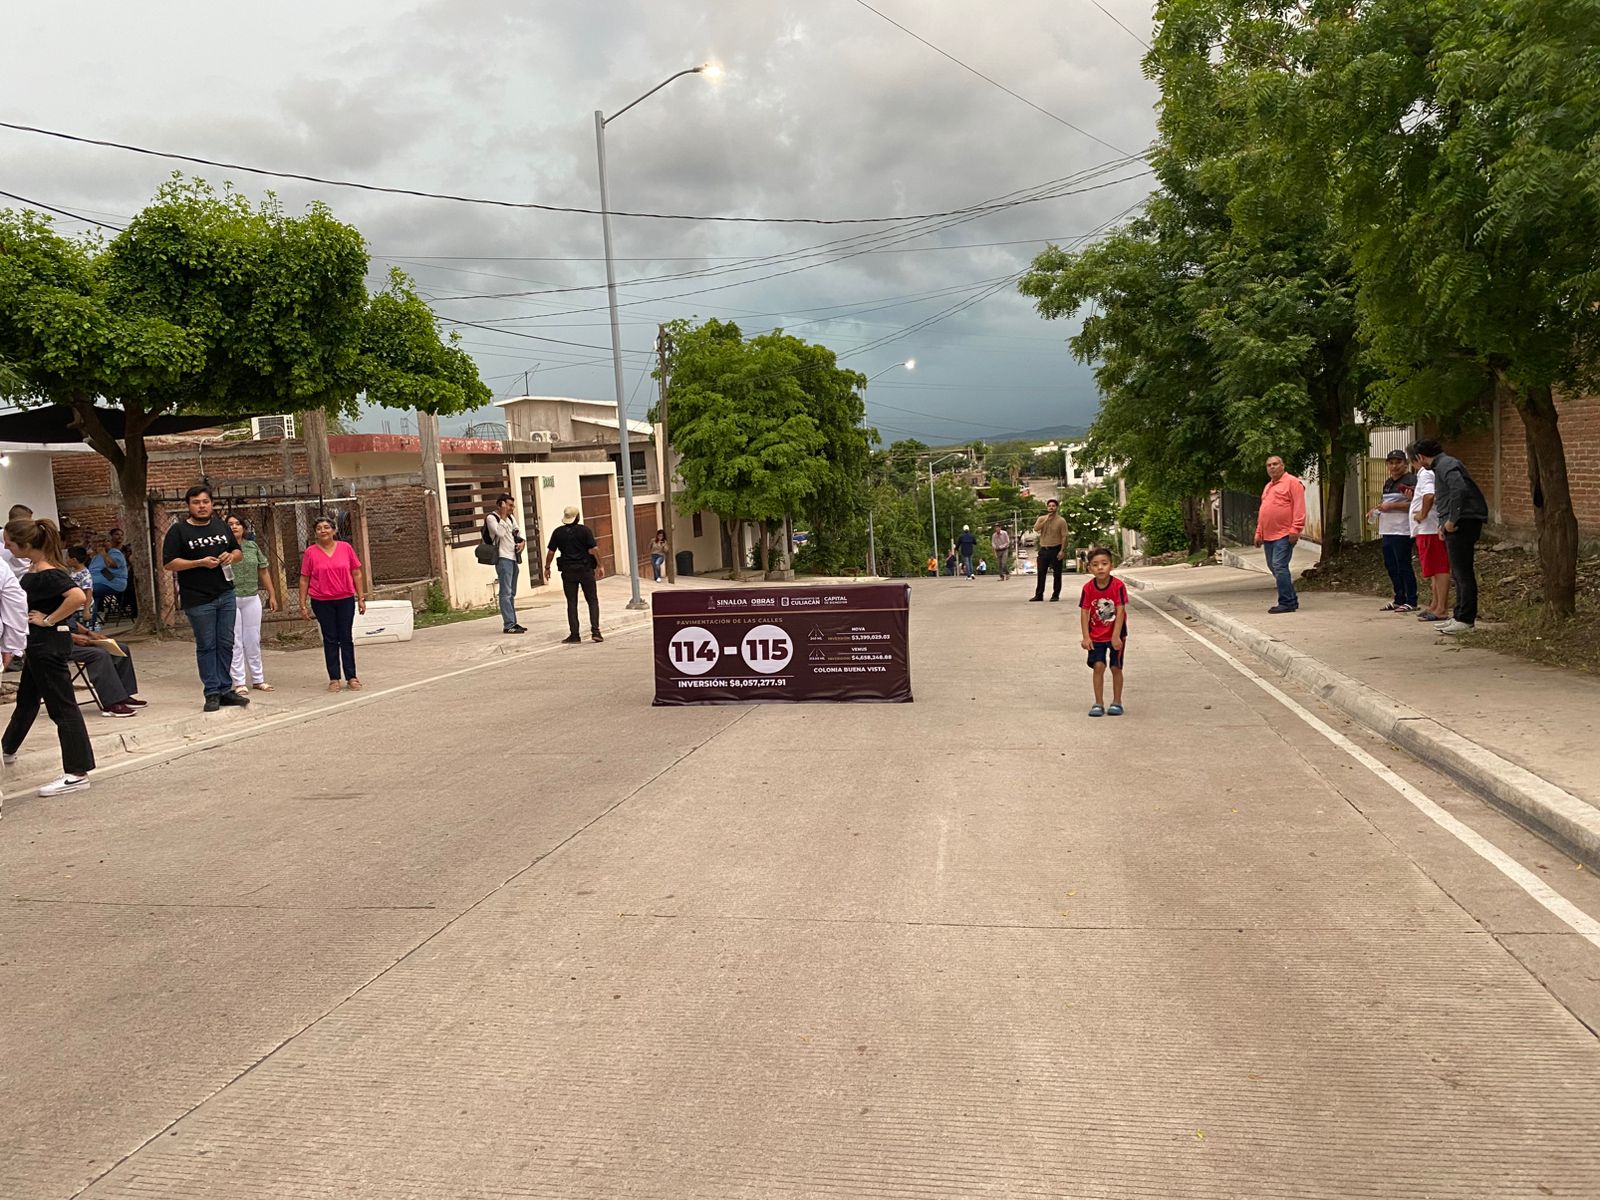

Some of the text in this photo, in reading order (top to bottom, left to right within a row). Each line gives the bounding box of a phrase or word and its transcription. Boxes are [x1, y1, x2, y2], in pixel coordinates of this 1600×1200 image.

[676, 618, 731, 626] PAVIMENTACIÓN
[671, 640, 717, 663] 114
[746, 638, 789, 661] 115
[678, 678, 786, 688] INVERSIÓN: $8,057,277.91
